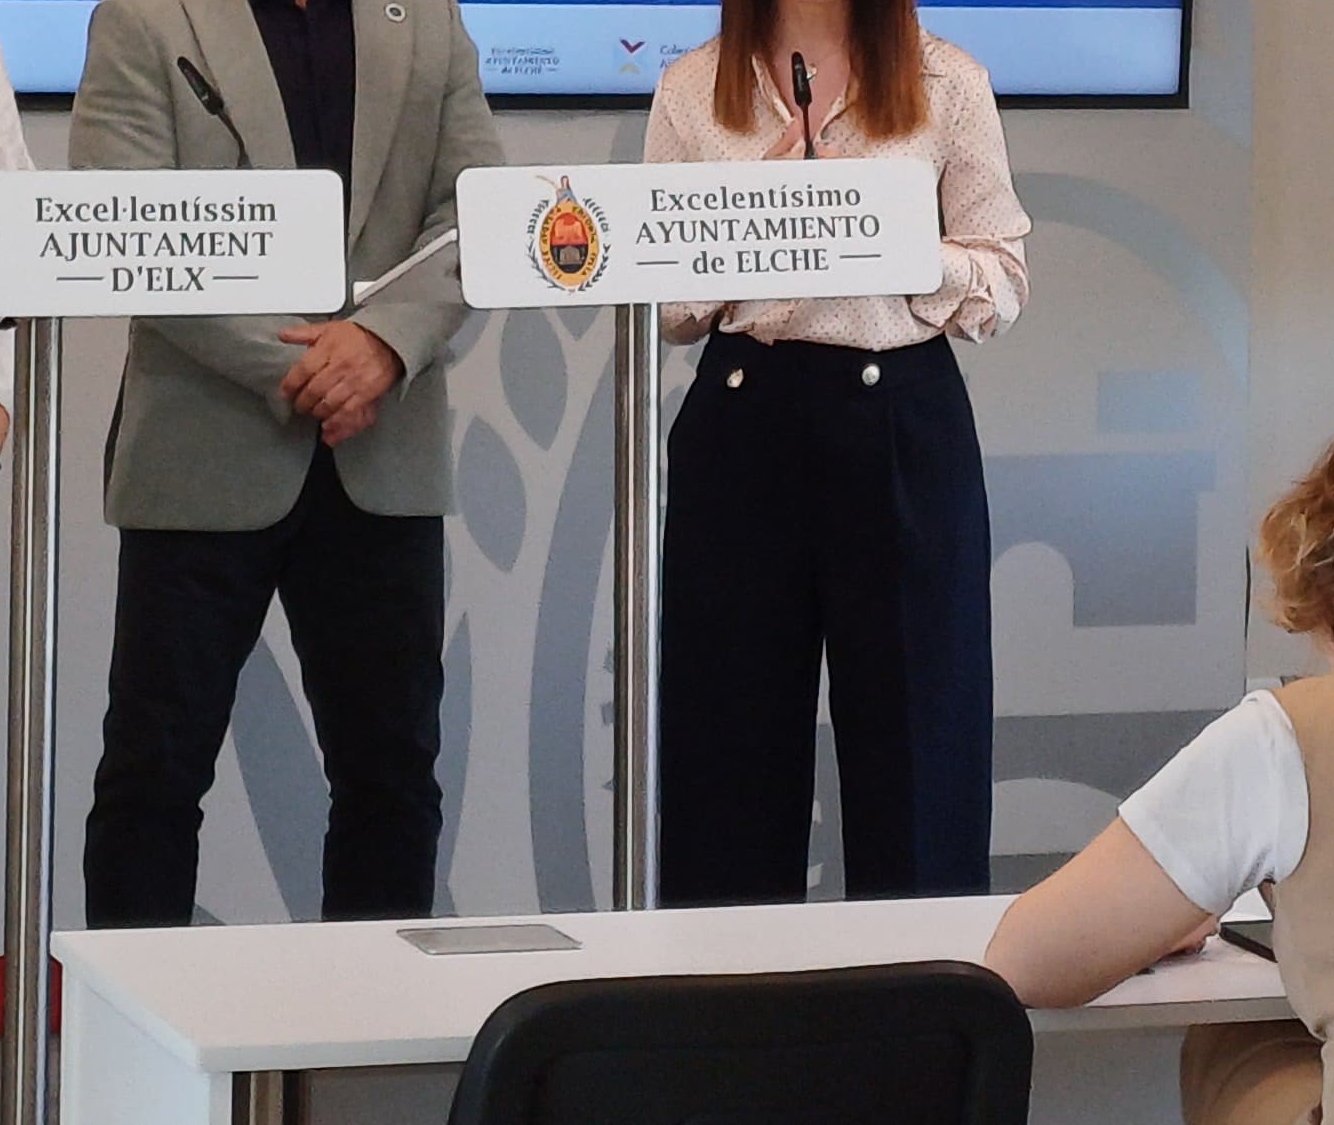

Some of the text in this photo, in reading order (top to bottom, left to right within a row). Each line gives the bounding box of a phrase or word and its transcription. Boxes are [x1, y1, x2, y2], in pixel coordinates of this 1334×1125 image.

[650, 184, 862, 213] Excelentísimo
[635, 213, 881, 246] AYUNTAMIENTO
[39, 230, 274, 262] AJUNTAMENT
[691, 247, 829, 276] de ELCHE
[111, 265, 205, 293] D'ELX
